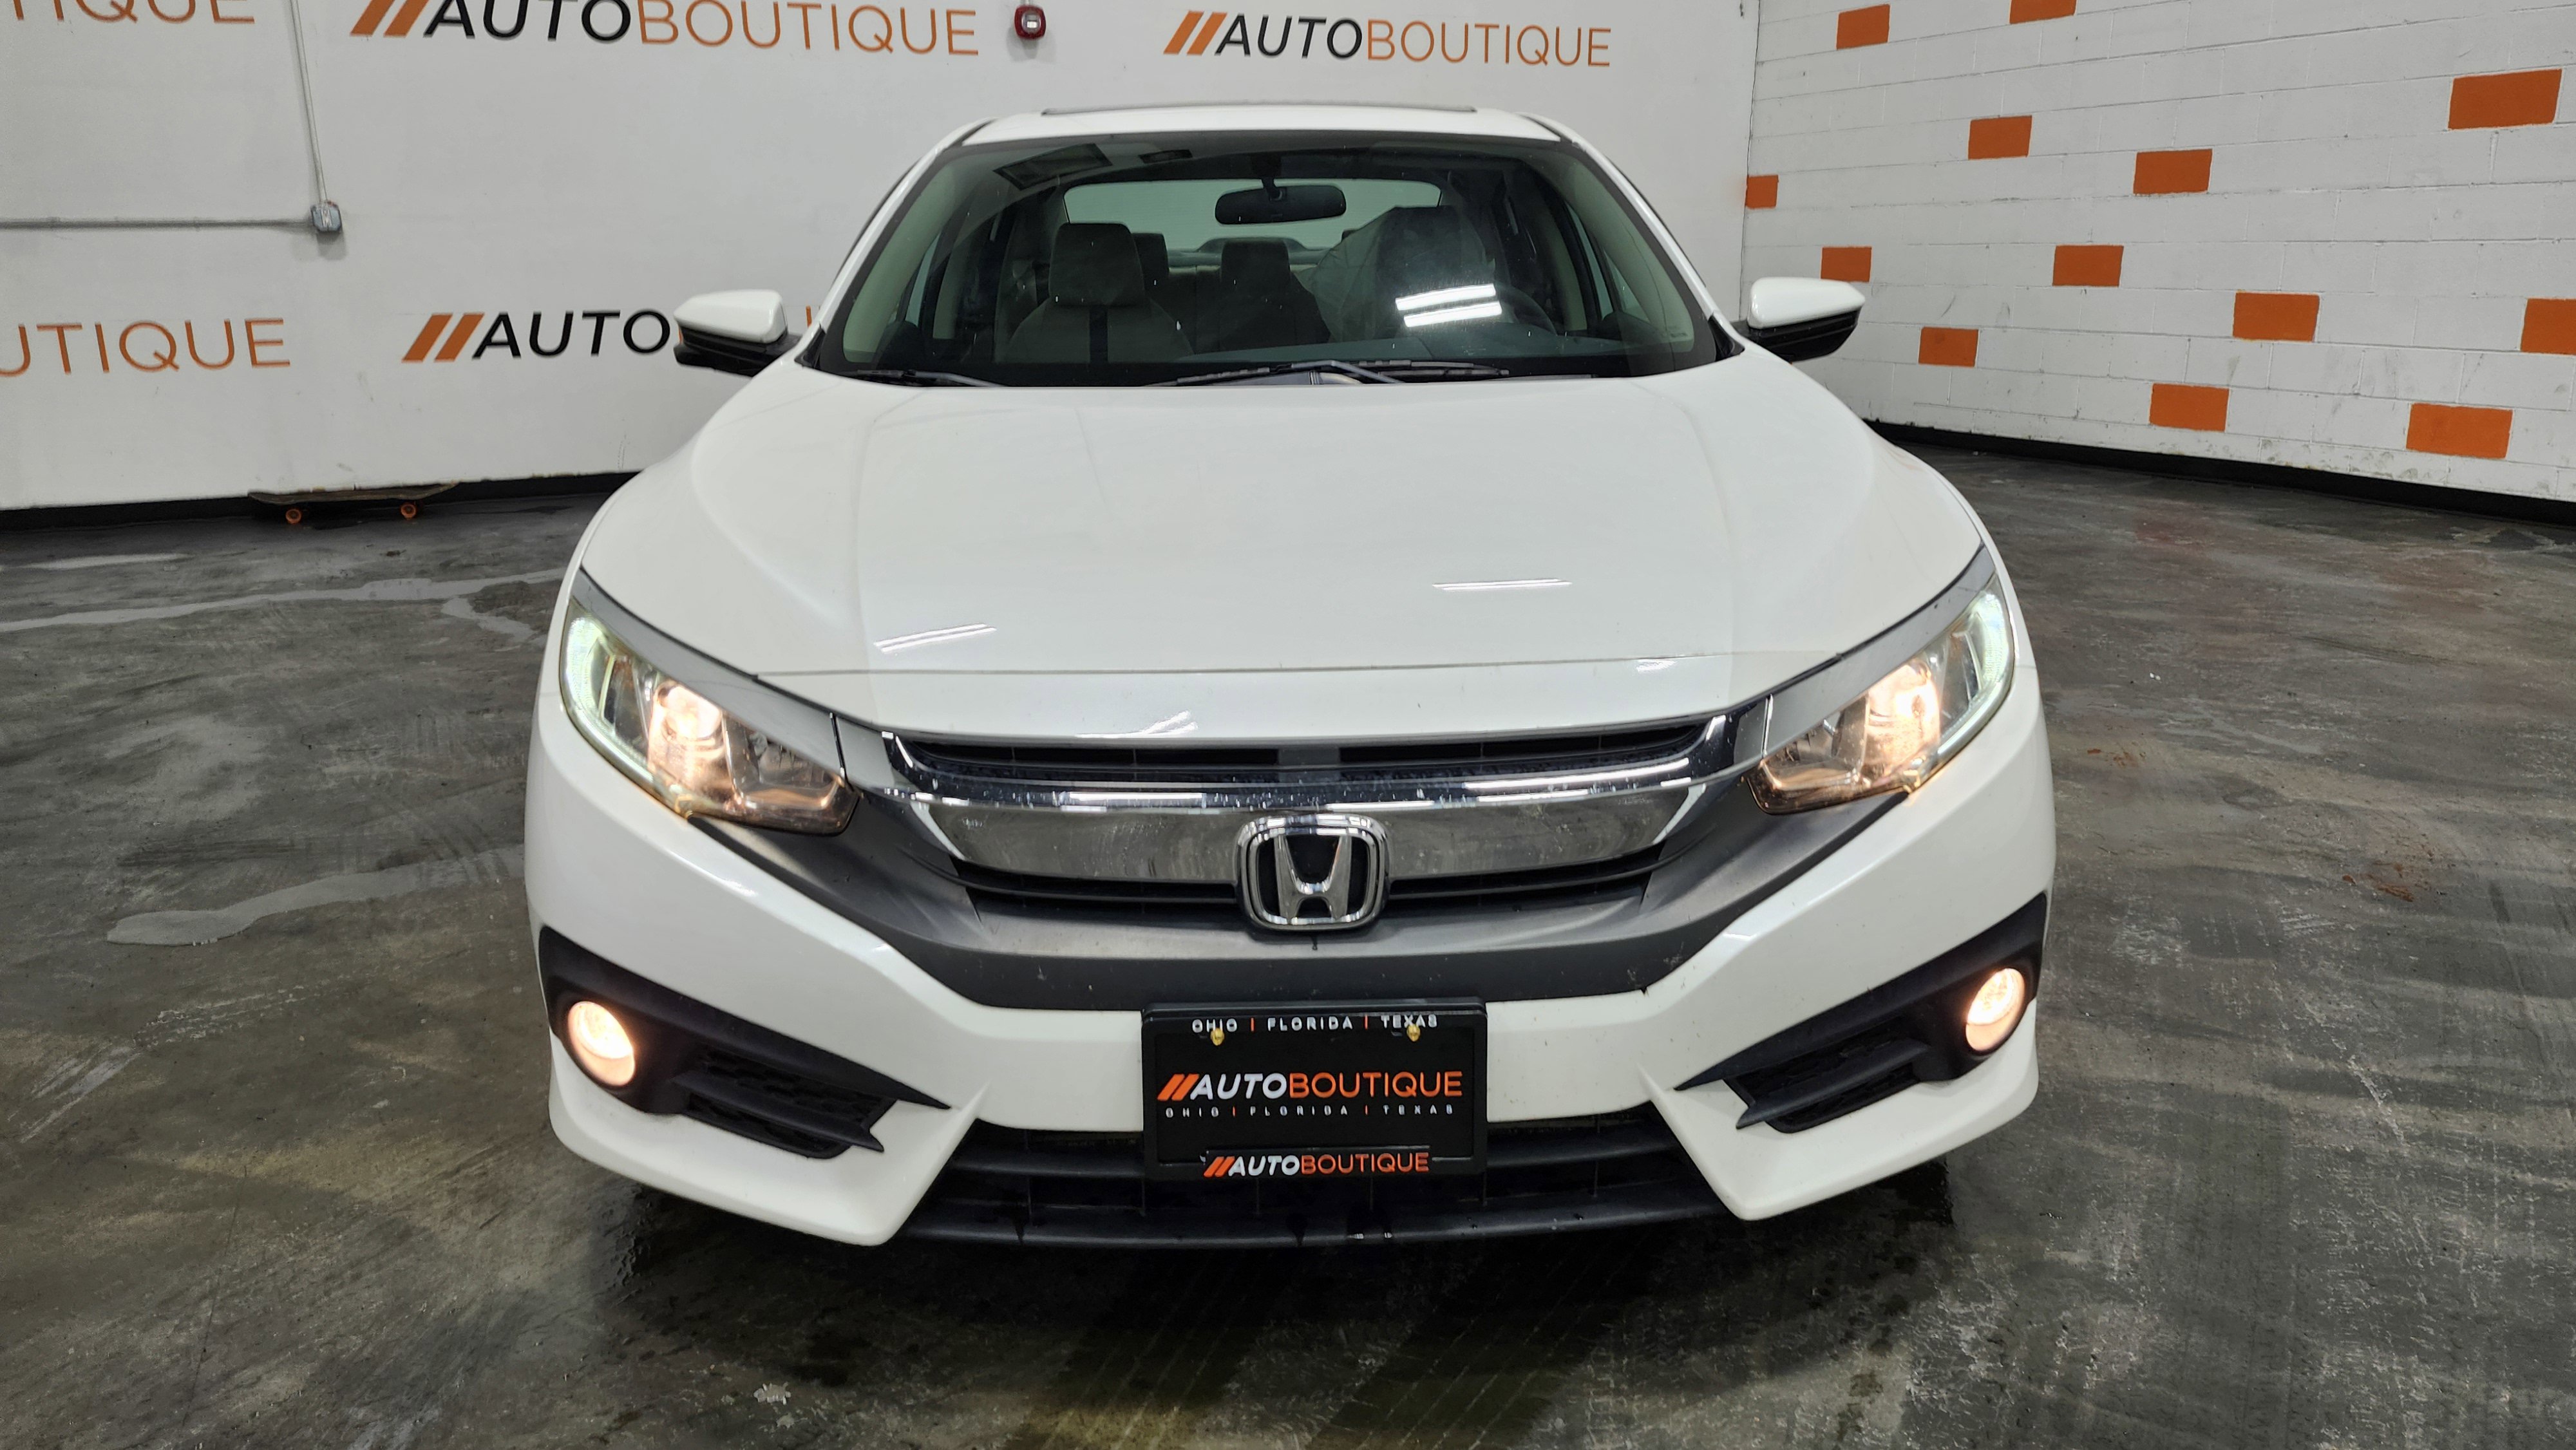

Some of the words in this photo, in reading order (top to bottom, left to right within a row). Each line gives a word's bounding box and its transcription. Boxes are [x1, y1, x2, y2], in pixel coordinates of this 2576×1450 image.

[422, 0, 979, 56] AUTOBOUTIQUE
[1215, 13, 1611, 68] AUTOBOUTIQUE
[1191, 1018, 1238, 1033] OHIO
[1267, 1015, 1354, 1032] FLORIDA
[1380, 1013, 1438, 1030] TEXAS
[1190, 1070, 1463, 1100] AUTOBOUTIQUE
[1165, 1106, 1220, 1118] OHIO
[1249, 1105, 1349, 1117] FLORIDA
[1383, 1104, 1454, 1116] TEXAS
[1227, 1152, 1430, 1178] AUTOBOUTIQUE
